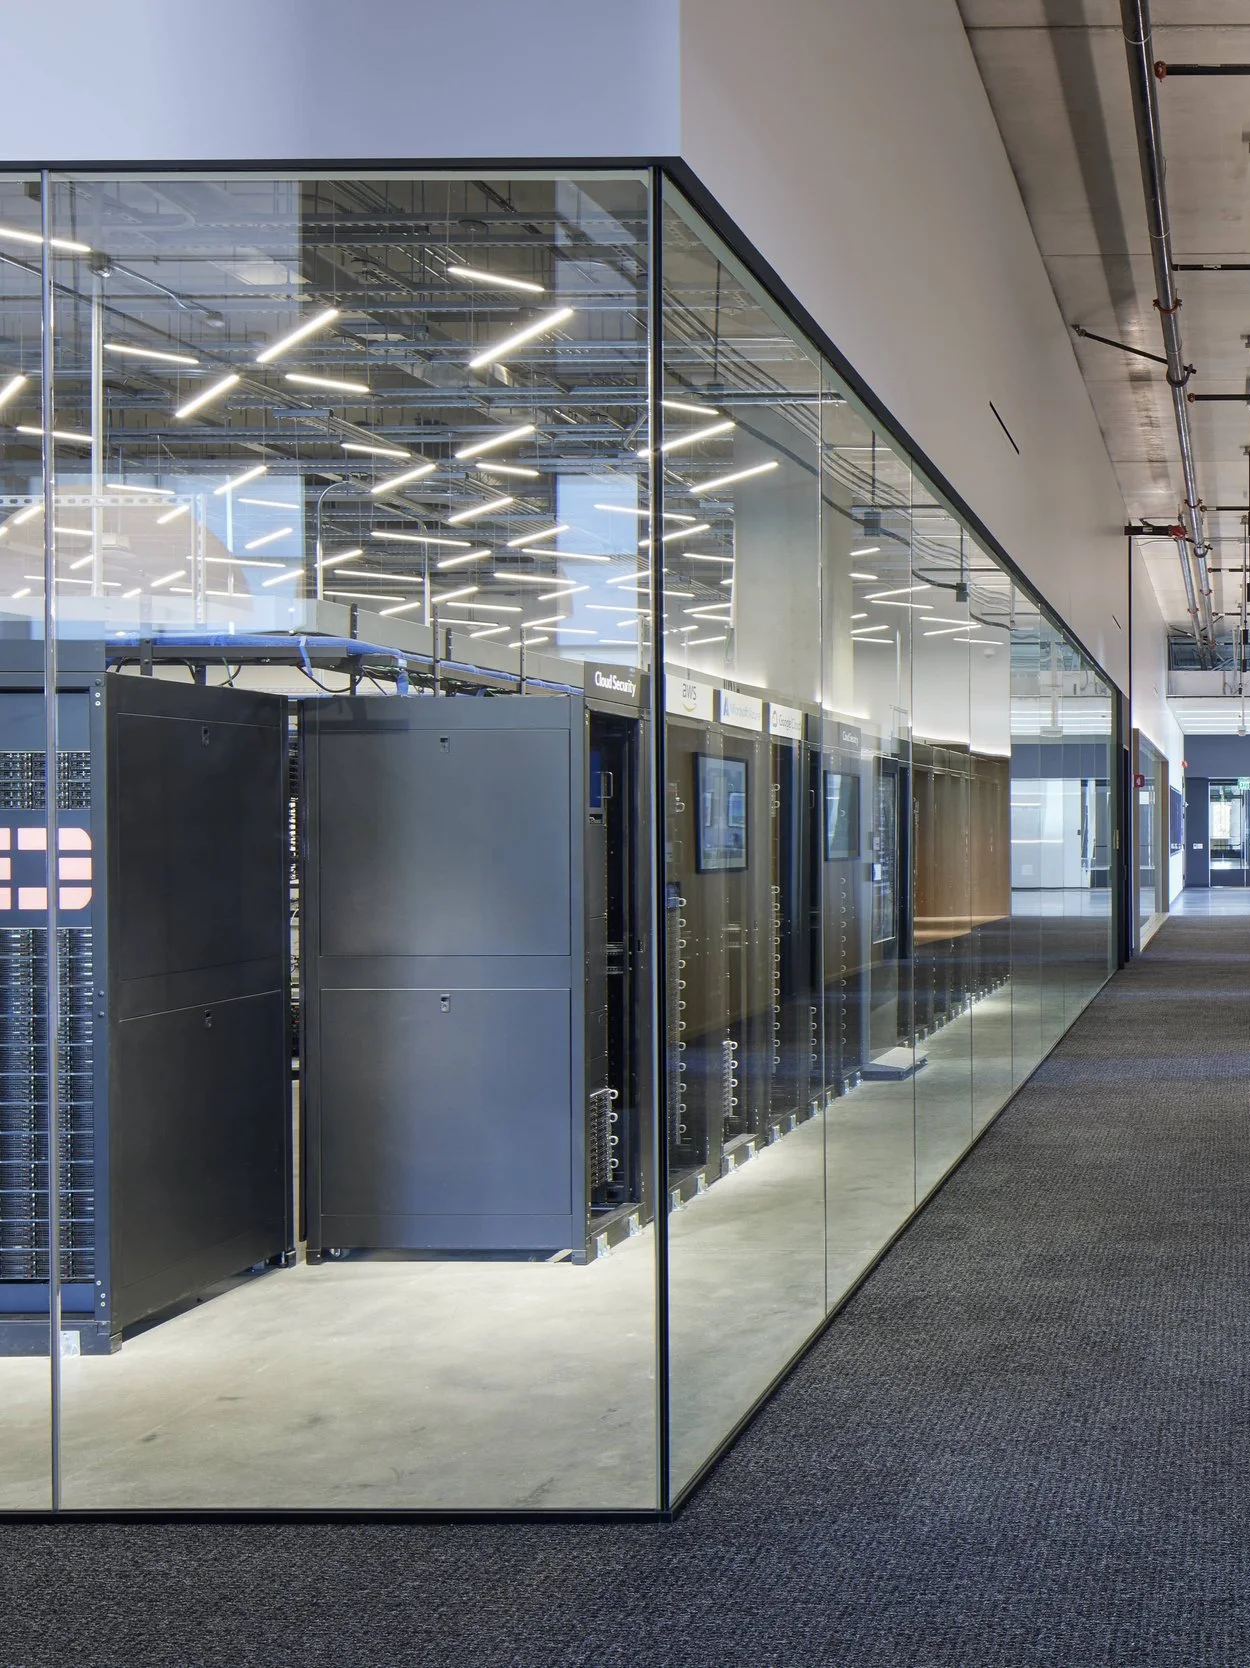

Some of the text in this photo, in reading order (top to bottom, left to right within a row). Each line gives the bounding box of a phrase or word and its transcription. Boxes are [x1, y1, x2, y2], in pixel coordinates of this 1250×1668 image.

[594, 670, 637, 698] Cloud Security
[682, 683, 697, 701] aws
